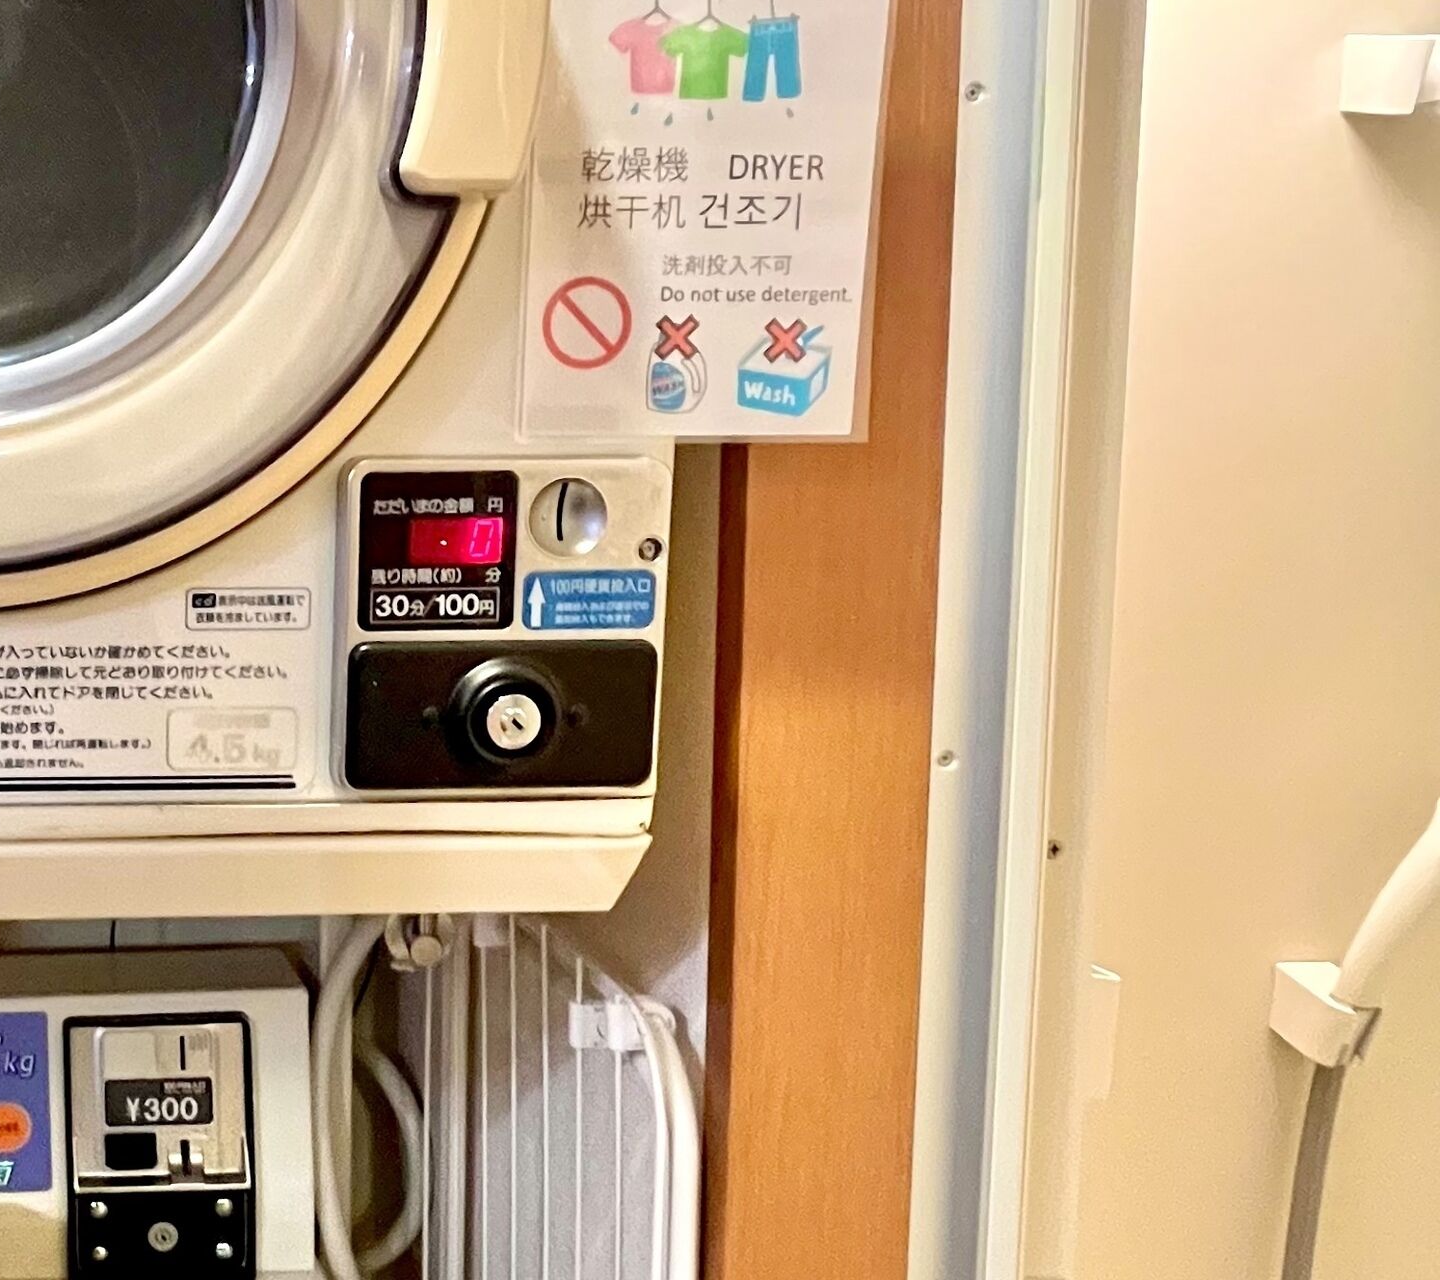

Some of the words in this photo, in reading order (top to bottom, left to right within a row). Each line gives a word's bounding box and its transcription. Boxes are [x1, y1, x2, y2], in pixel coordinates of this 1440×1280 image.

[580, 147, 689, 183] 乾燥機
[729, 154, 825, 181] DRYER
[577, 193, 686, 230] 烘干机
[699, 192, 803, 231] 건조기
[661, 254, 793, 276] 洗剤投入不可
[660, 286, 685, 303] Do
[691, 287, 723, 302] not
[726, 288, 756, 302] use
[761, 285, 853, 306] detergent.
[743, 381, 796, 407] Wash
[487, 497, 503, 513] 円
[468, 519, 494, 558] 0
[485, 567, 502, 583] 分
[126, 1096, 199, 1122] ¥300
